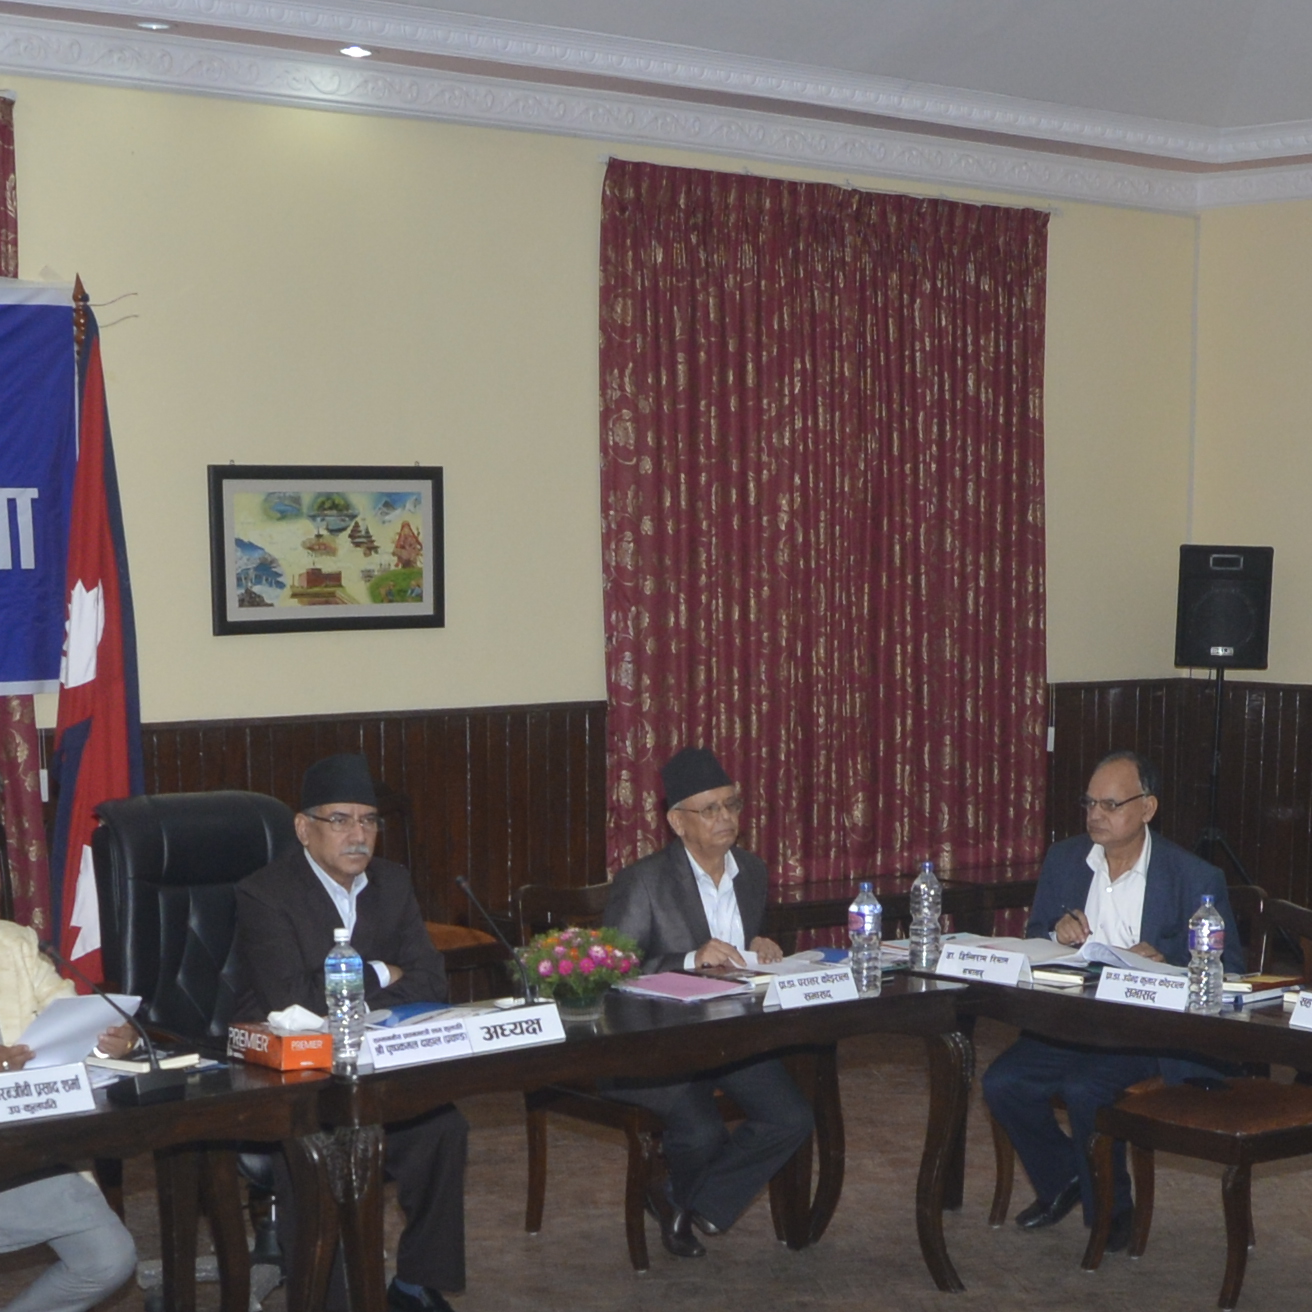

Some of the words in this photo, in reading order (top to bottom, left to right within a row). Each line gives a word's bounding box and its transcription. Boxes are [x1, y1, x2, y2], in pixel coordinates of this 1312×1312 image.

[228, 1026, 270, 1053] PREMIER
[479, 1017, 544, 1042] अध्यक्ष
[291, 1040, 324, 1051] PREMIER
